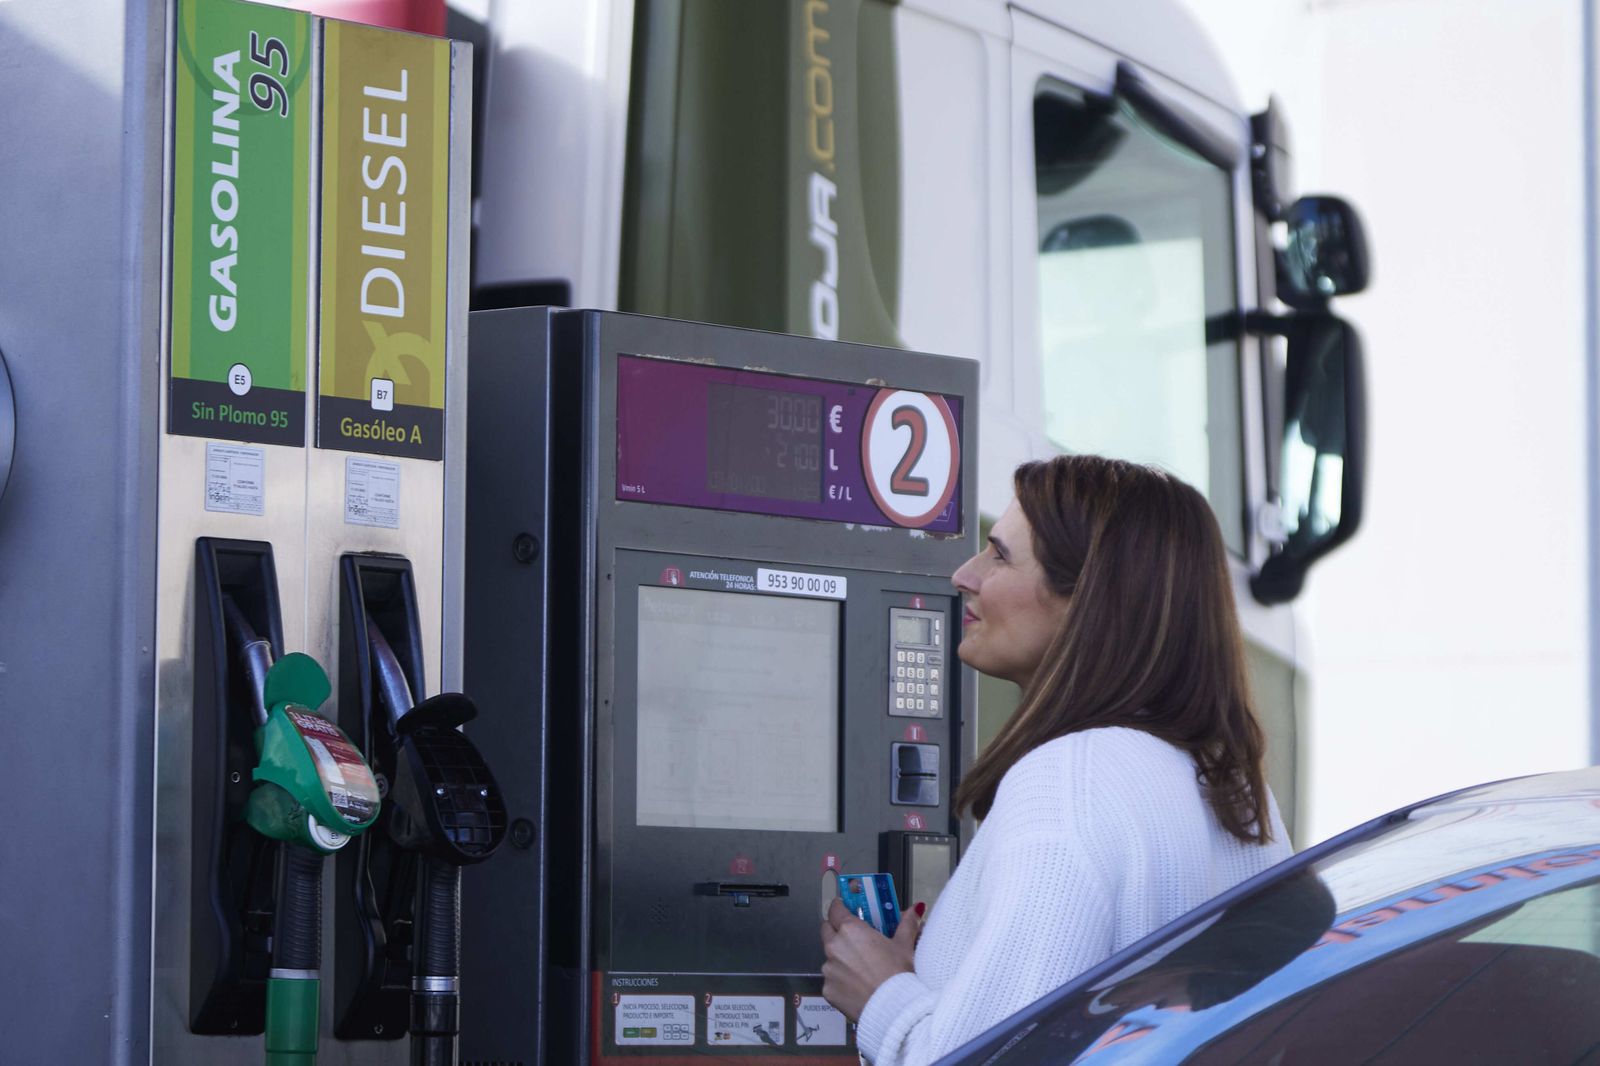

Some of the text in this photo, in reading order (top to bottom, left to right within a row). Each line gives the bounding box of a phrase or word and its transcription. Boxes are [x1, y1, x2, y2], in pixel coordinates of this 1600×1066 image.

[249, 31, 289, 117] 95
[209, 50, 240, 332] GASOLINA
[360, 69, 408, 318] DIESEL
[234, 374, 246, 386] E5
[376, 389, 388, 400] B7
[191, 401, 288, 428] Sin Plomo 95
[829, 404, 843, 433] €
[340, 417, 422, 444] Gasóleo A
[829, 448, 838, 470] L
[890, 404, 929, 497] 2
[689, 570, 754, 583] ATENCIÓN TELEFONICA
[768, 574, 837, 594] 953 90 00 09
[612, 978, 659, 987] INSTRUCCIONES
